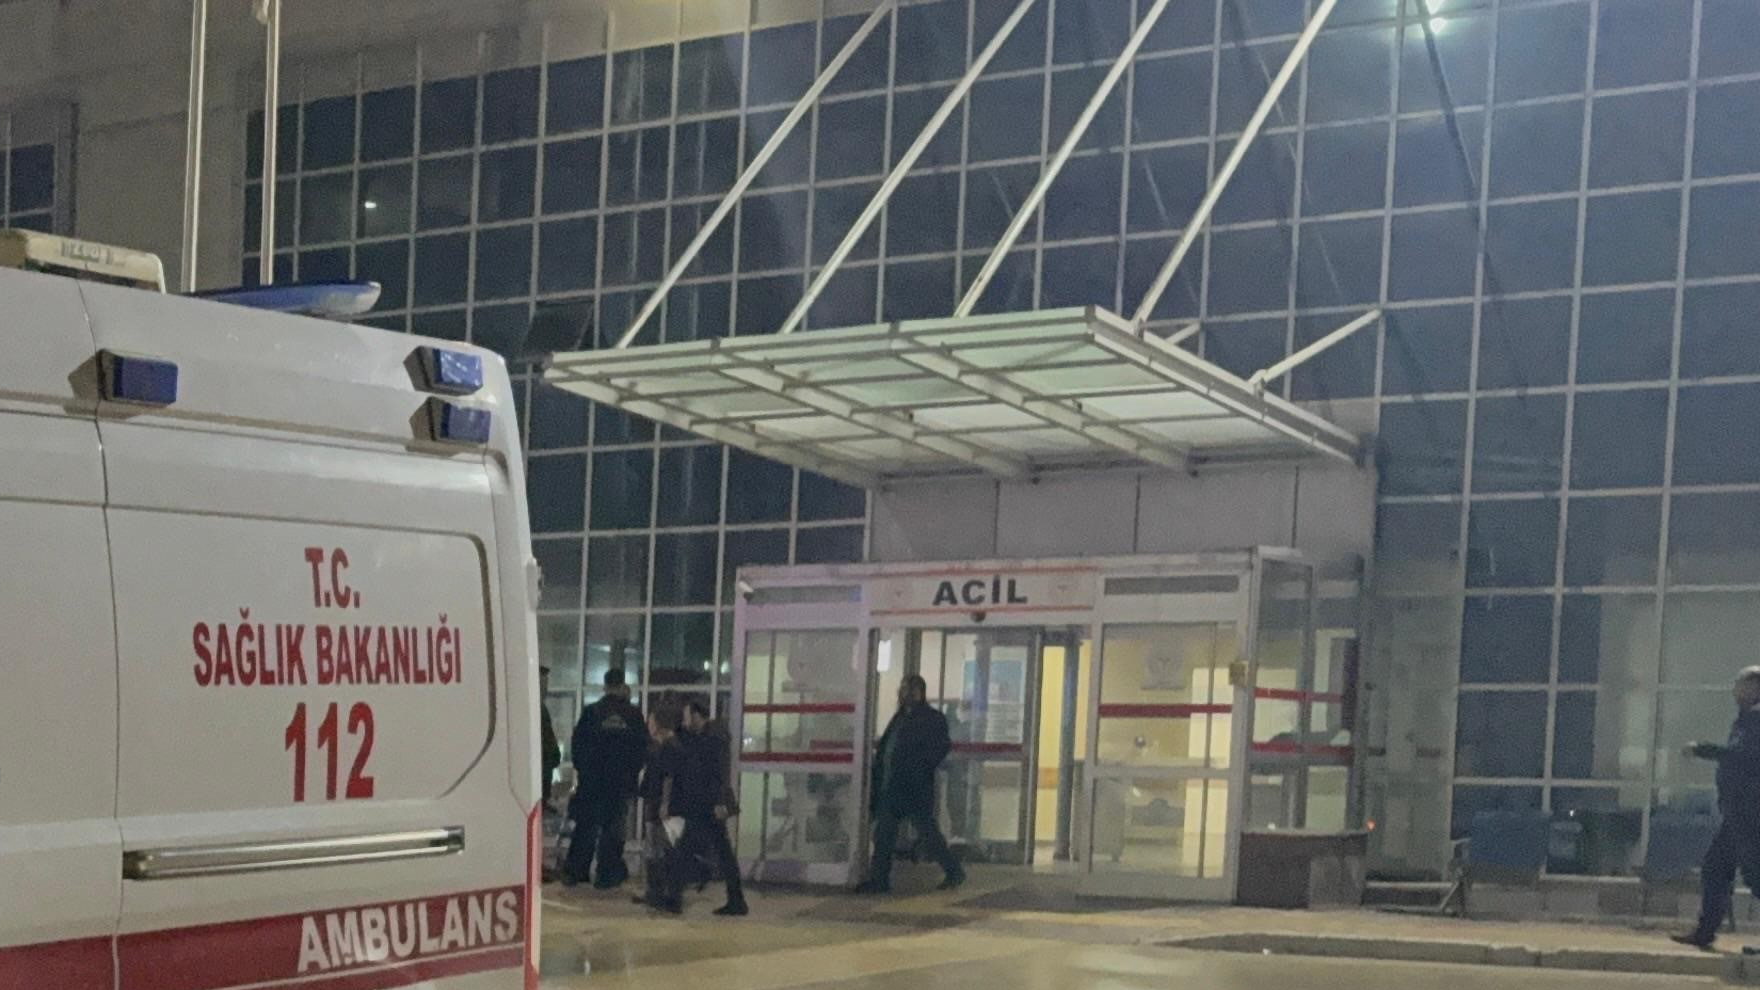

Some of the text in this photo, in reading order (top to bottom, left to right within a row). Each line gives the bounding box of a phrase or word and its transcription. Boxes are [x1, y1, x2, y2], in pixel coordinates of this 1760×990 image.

[304, 547, 361, 609] T.C.
[932, 574, 1028, 606] ACİL
[192, 607, 462, 686] SAĞLIK BAKANLIĞI
[285, 701, 375, 802] 112
[297, 891, 519, 974] AMBULANS
